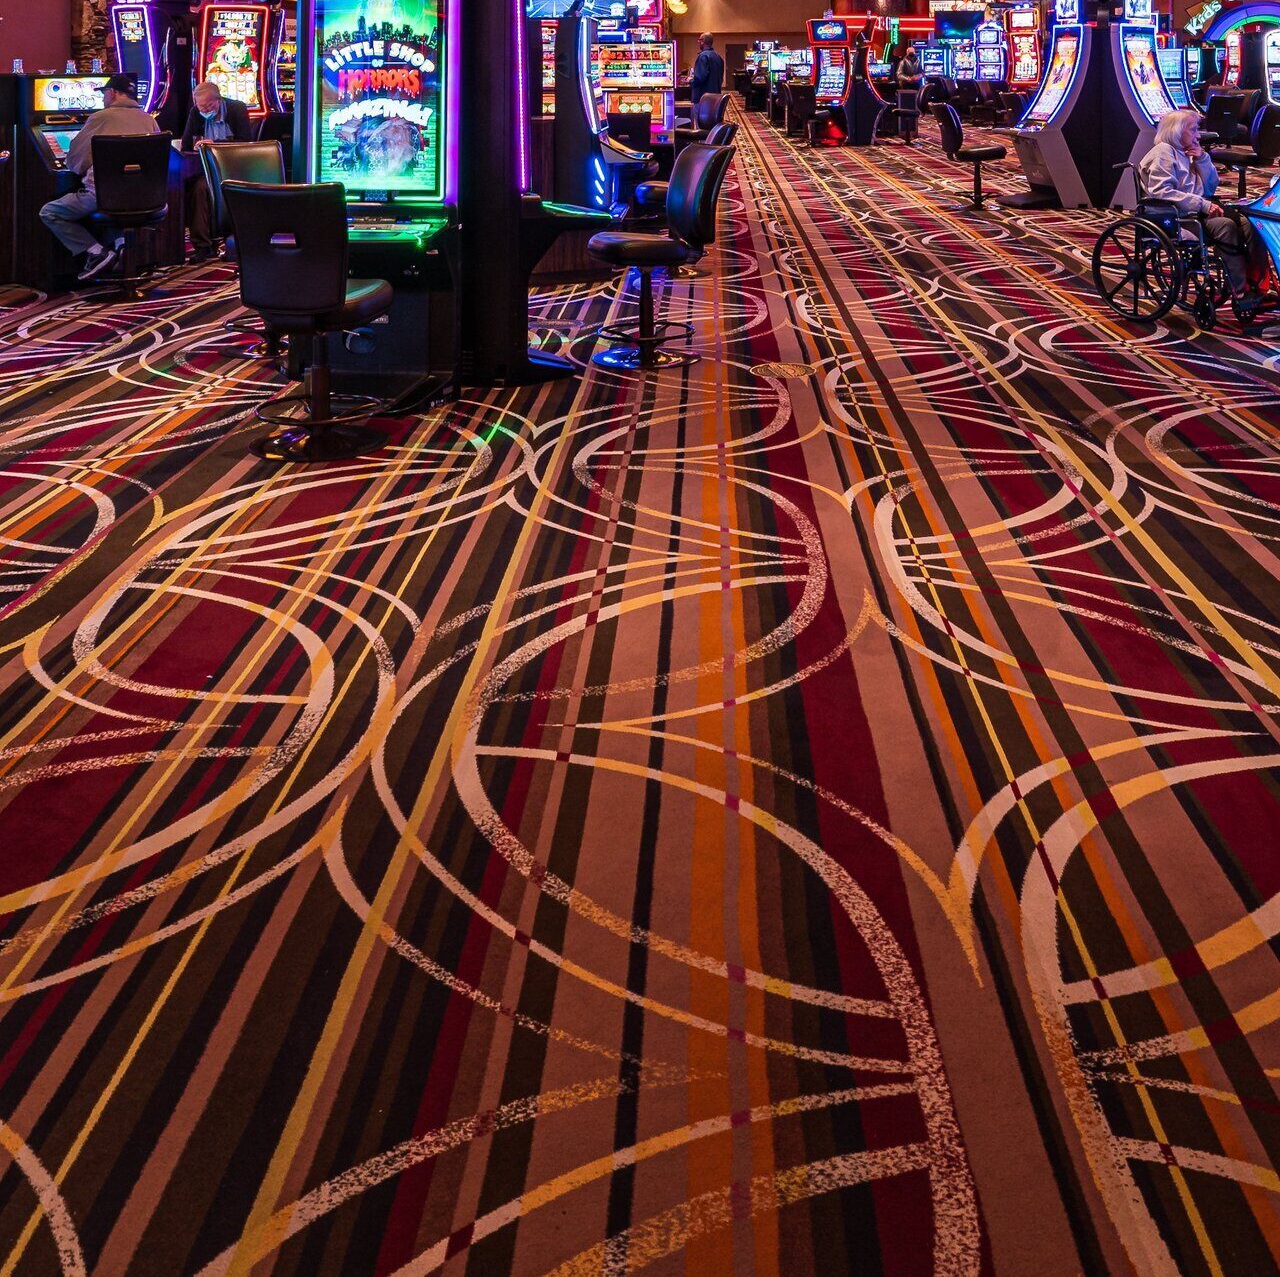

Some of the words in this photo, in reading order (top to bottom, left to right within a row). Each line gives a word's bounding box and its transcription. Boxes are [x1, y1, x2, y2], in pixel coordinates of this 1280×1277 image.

[1184, 0, 1223, 37] Kids
[389, 42, 435, 73] SHOP
[338, 68, 420, 100] HORRORS
